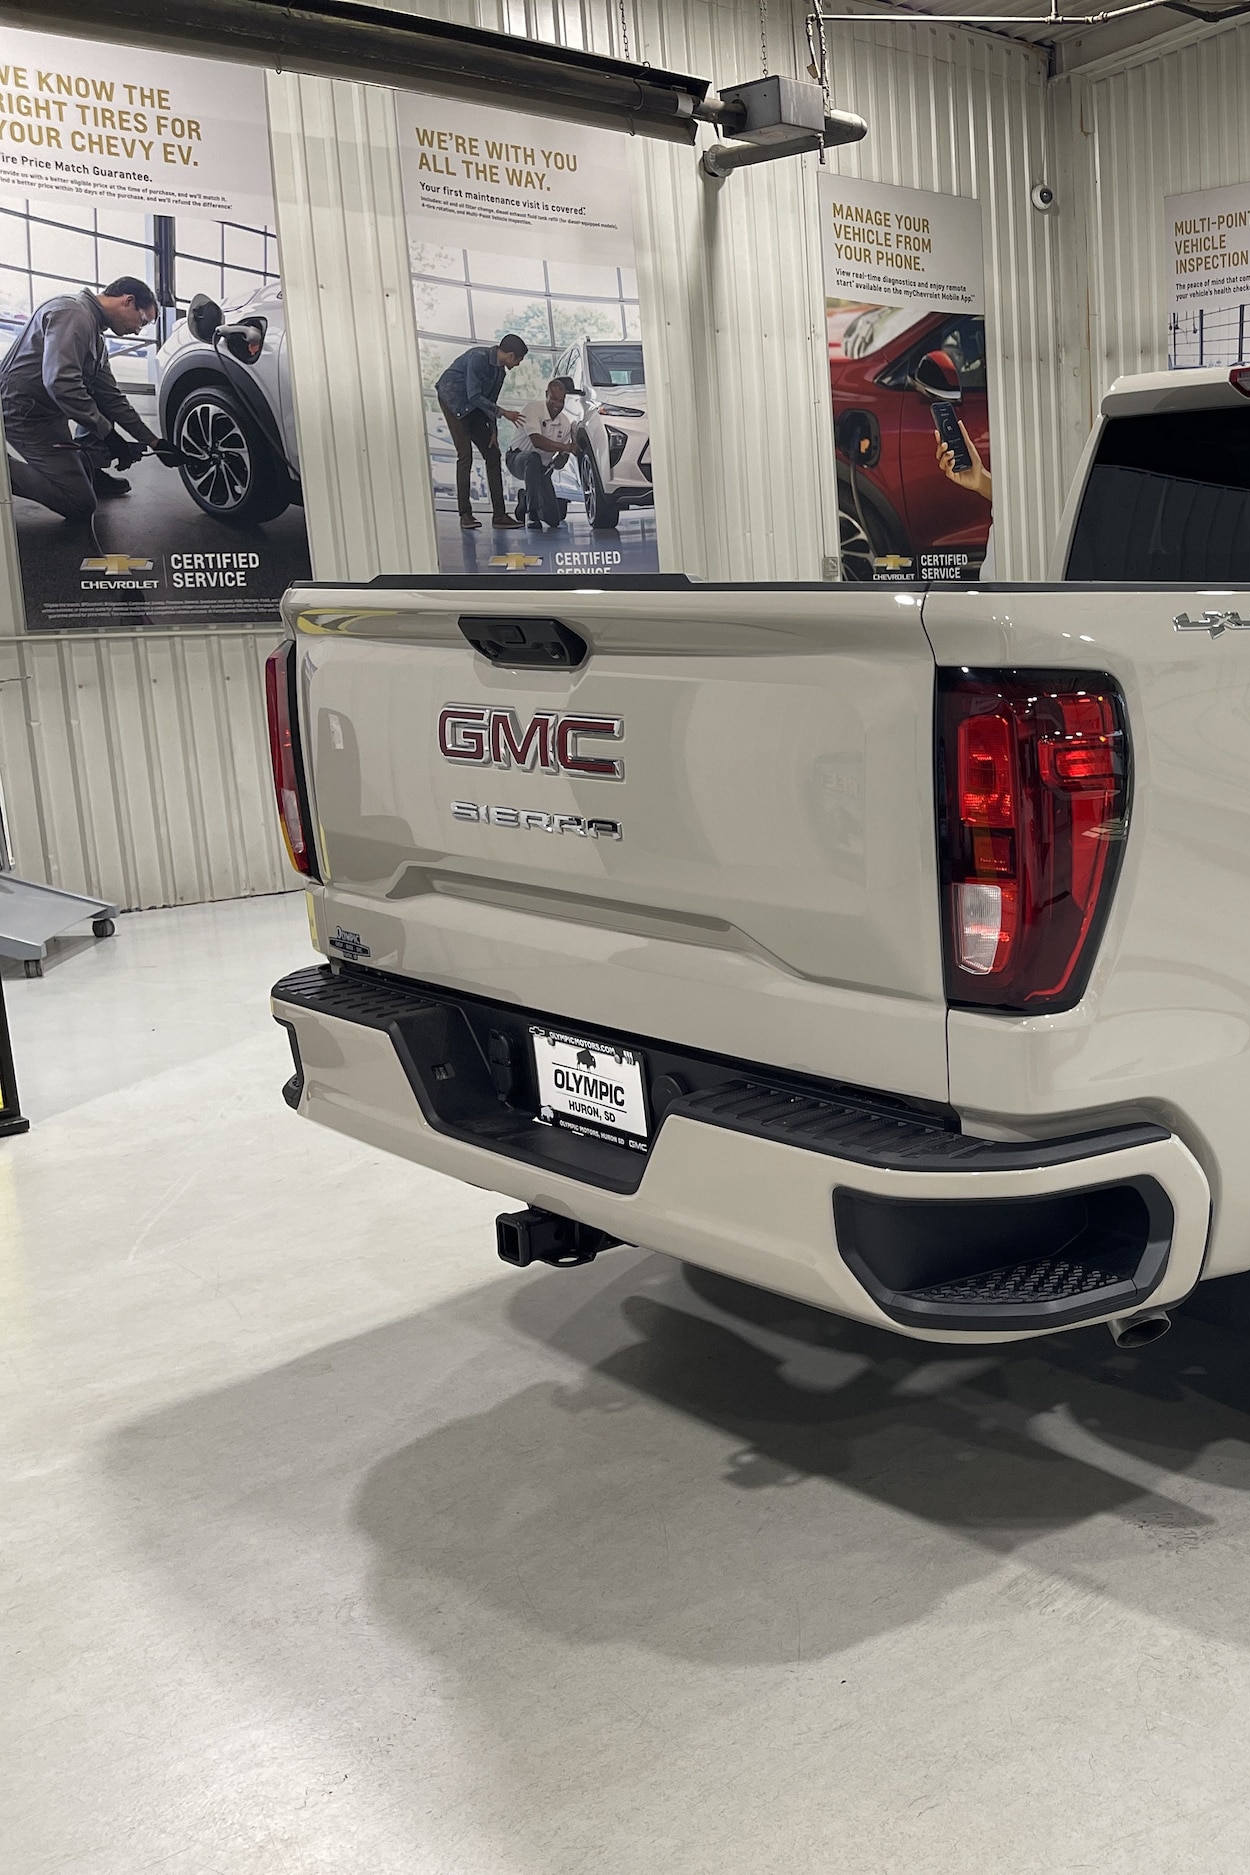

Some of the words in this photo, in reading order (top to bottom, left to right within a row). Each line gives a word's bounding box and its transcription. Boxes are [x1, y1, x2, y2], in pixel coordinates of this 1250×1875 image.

[37, 71, 115, 102] KNOW
[123, 84, 171, 110] THE
[75, 104, 148, 133] TIRES
[156, 115, 202, 141] FOR
[71, 130, 155, 161] CHEVY
[163, 142, 198, 167] EV.
[415, 127, 480, 156] WE'RE
[485, 140, 536, 166] WITH
[541, 150, 578, 172] YOU
[0, 152, 18, 164] ire
[21, 155, 52, 169] Price
[55, 160, 90, 175] Match
[92, 166, 153, 183] Guarantee.
[418, 152, 457, 176] ALL
[461, 160, 500, 183] THE
[505, 167, 551, 192] WAY.
[17, 179, 36, 187] better
[50, 176, 69, 184] better
[419, 181, 441, 193] Your
[443, 186, 463, 197] first
[465, 191, 520, 207] maintenance
[522, 200, 540, 210] visit
[542, 202, 549, 210] is
[832, 202, 892, 228] MANAGE
[895, 214, 930, 234] YOUR
[833, 223, 892, 248] VEHICLE
[896, 234, 932, 253] FROM
[1175, 234, 1227, 256] VEHICLE
[835, 243, 873, 264] YOUR
[876, 251, 926, 272] PHONE.
[1175, 250, 1249, 274] INSPECTION
[835, 268, 851, 278] View
[852, 271, 881, 282] real-time
[882, 276, 916, 288] diagnostics
[918, 281, 929, 289] and
[930, 283, 945, 292] enjoy
[855, 282, 882, 293] available
[892, 287, 902, 295] the
[904, 289, 941, 300] myChevrolet
[941, 292, 960, 301] Mobile
[1176, 282, 1186, 290] The
[1186, 280, 1203, 291] peace
[1204, 278, 1210, 287] of
[1211, 276, 1225, 286] mind
[1226, 274, 1238, 284] that
[1175, 292, 1188, 302] your
[1189, 287, 1213, 299] vehicle's
[1214, 285, 1232, 296] health
[170, 553, 260, 570] CERTIFIED
[555, 551, 621, 566] CERTIFIED
[920, 554, 968, 566] CERTIFIED
[80, 580, 159, 590] CHEVROLET
[172, 571, 247, 588] SERVICE
[872, 573, 915, 581] CHEVROLET
[921, 567, 961, 580] SERVICE
[438, 702, 626, 784] GMC
[450, 800, 624, 842] SIERRA
[554, 1068, 626, 1107] OLYMPIC
[568, 1100, 602, 1120] HURON,
[604, 1110, 616, 1123] SD
[628, 1139, 648, 1152] GMC
